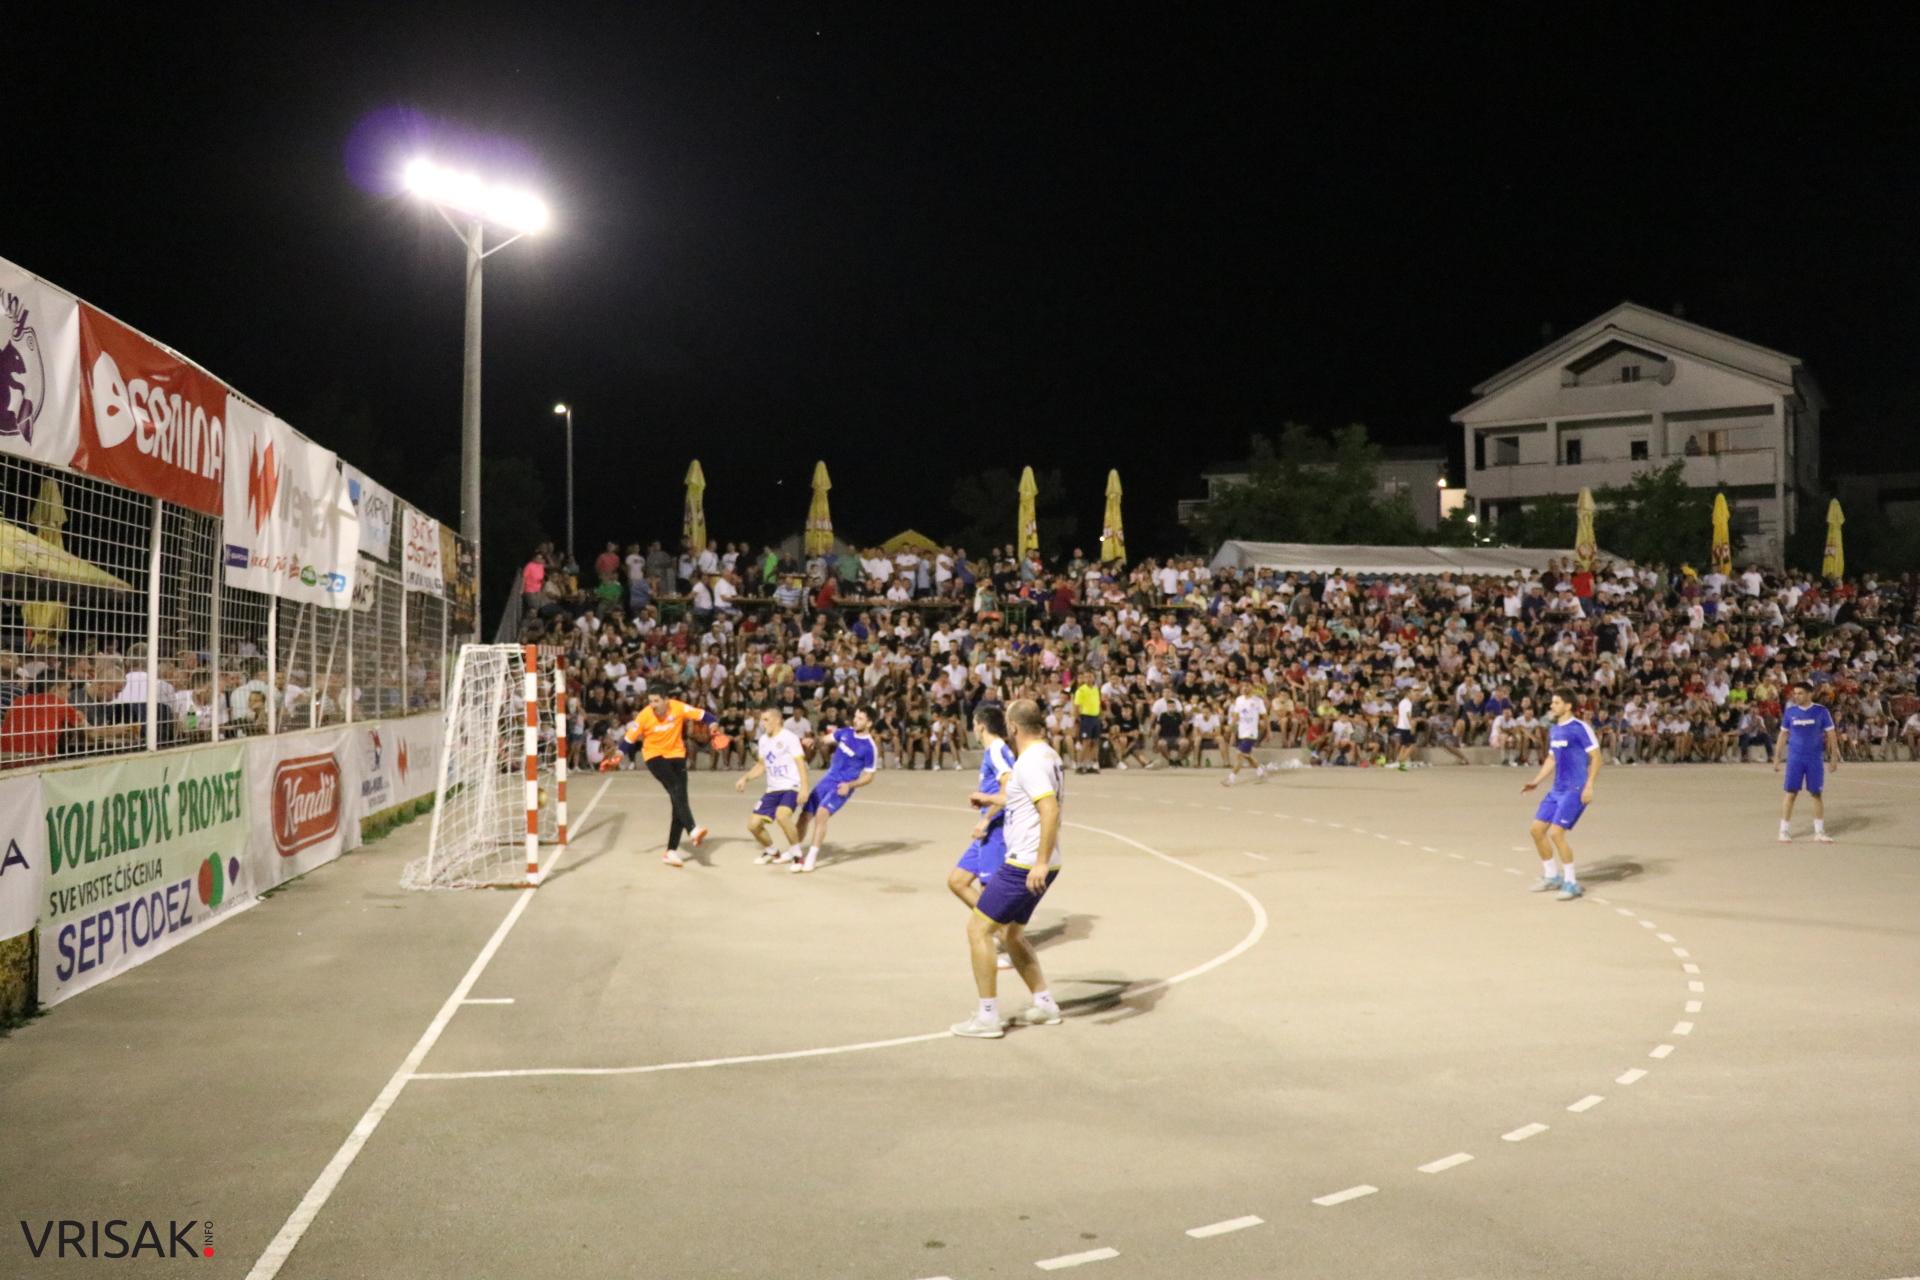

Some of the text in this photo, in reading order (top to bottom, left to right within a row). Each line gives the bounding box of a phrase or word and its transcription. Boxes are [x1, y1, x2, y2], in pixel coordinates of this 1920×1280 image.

[46, 767, 243, 875] VOLAREVIĆ PROMET
[283, 772, 336, 838] Kandit
[50, 887, 76, 917] SVE
[78, 874, 112, 907] VRSTE
[56, 879, 193, 982] SEPTODEZ
